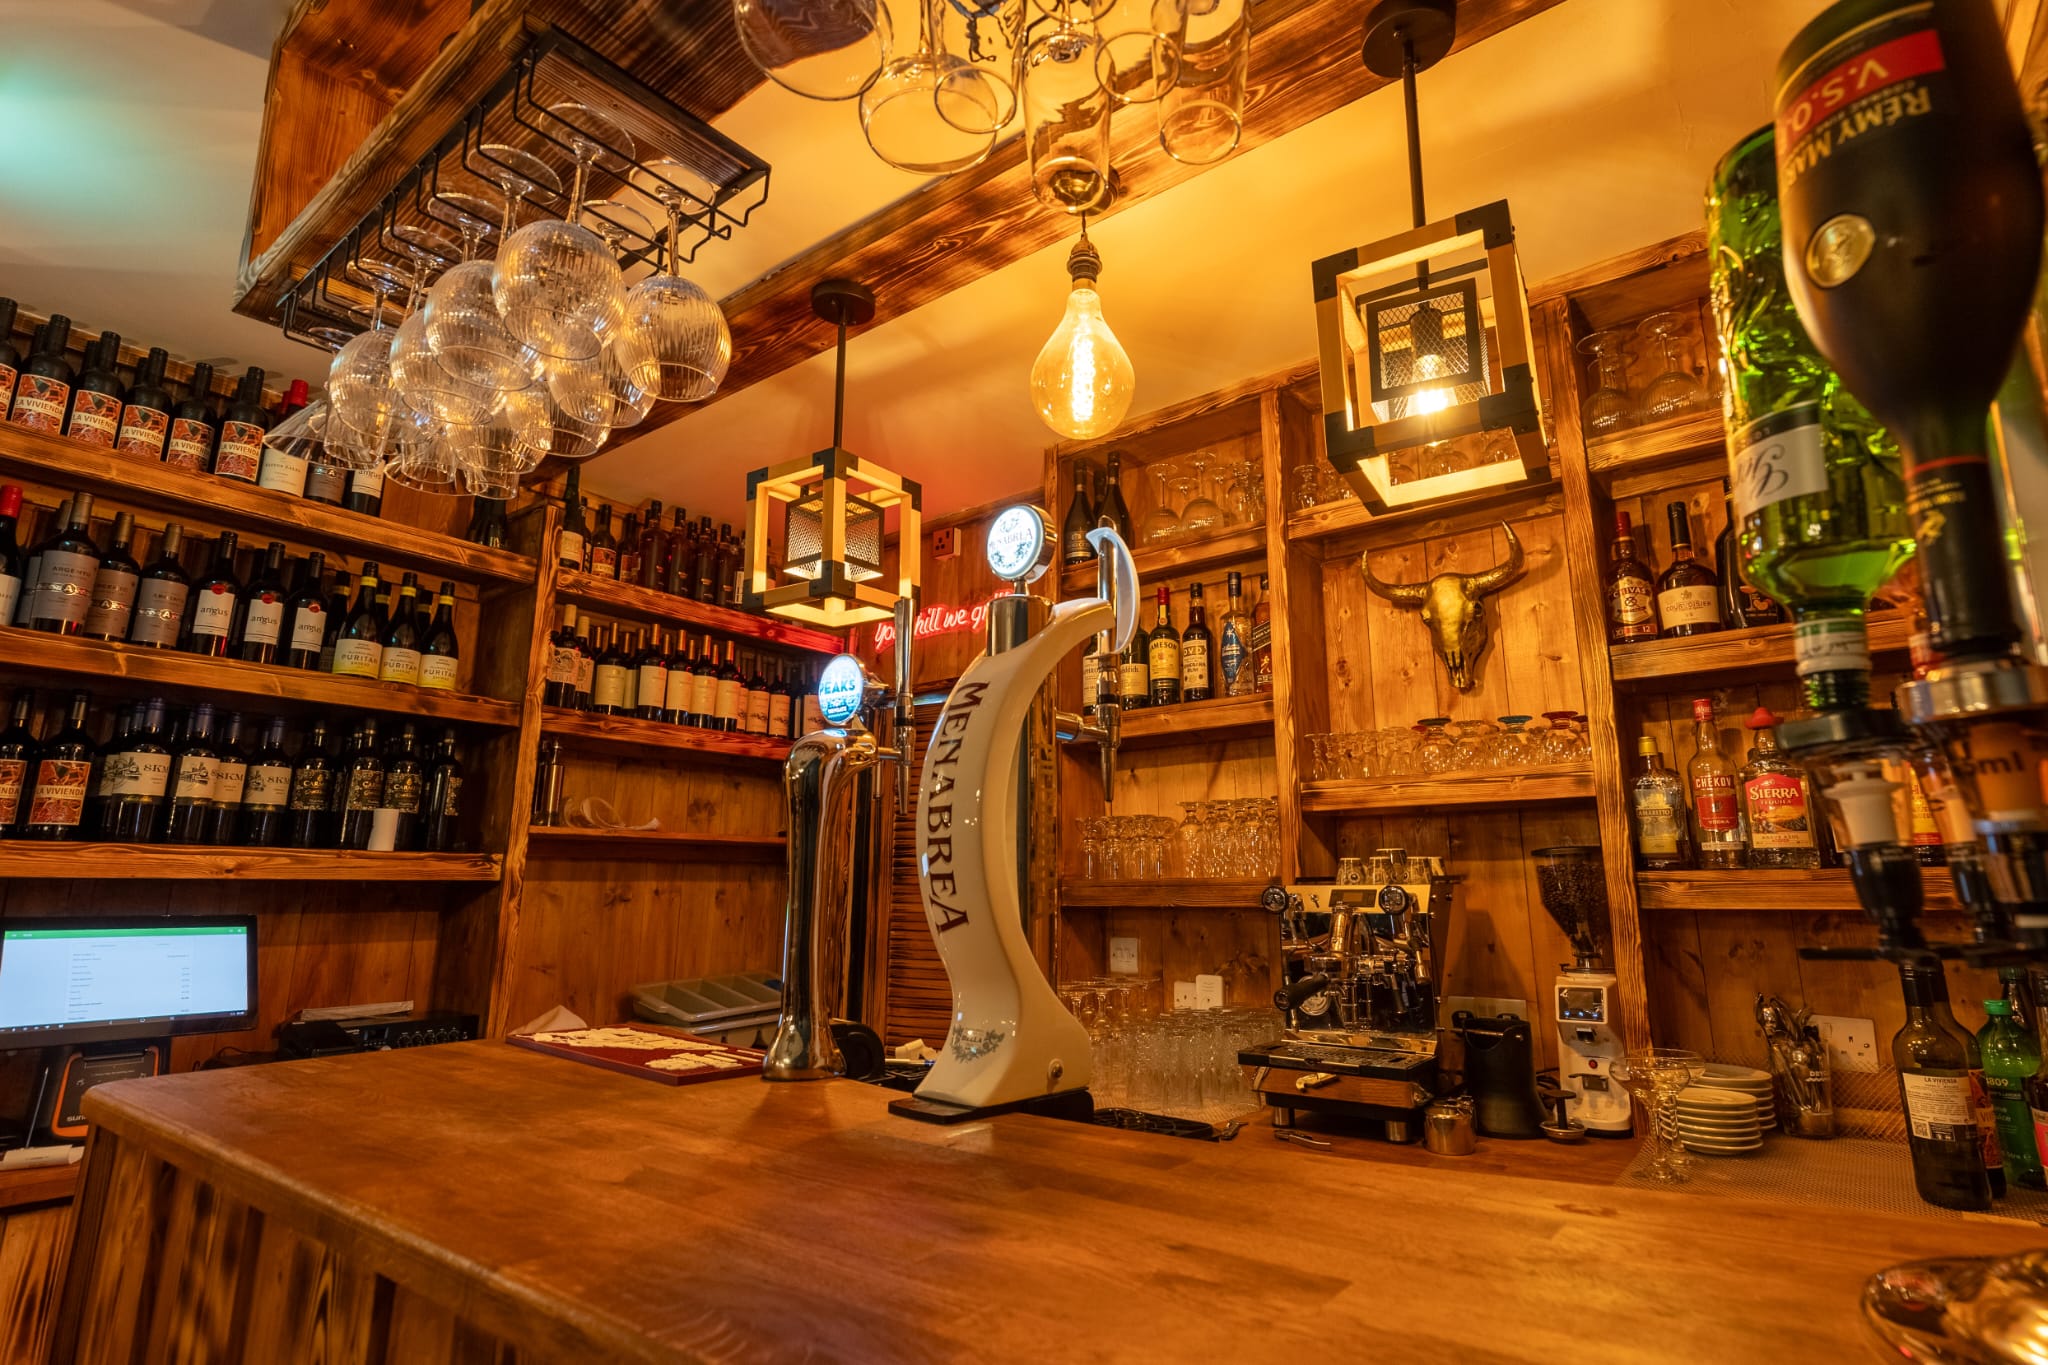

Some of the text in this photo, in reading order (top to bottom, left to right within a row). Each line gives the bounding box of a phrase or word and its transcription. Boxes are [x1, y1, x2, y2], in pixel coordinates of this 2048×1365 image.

[1837, 86, 1932, 145] RÉMY
[914, 606, 942, 636] hill
[943, 608, 967, 629] we
[1151, 641, 1178, 650] AMESON
[1695, 777, 1732, 789] CHEKOV
[1749, 784, 1799, 800] SIERRA
[926, 680, 992, 938] MENABREA
